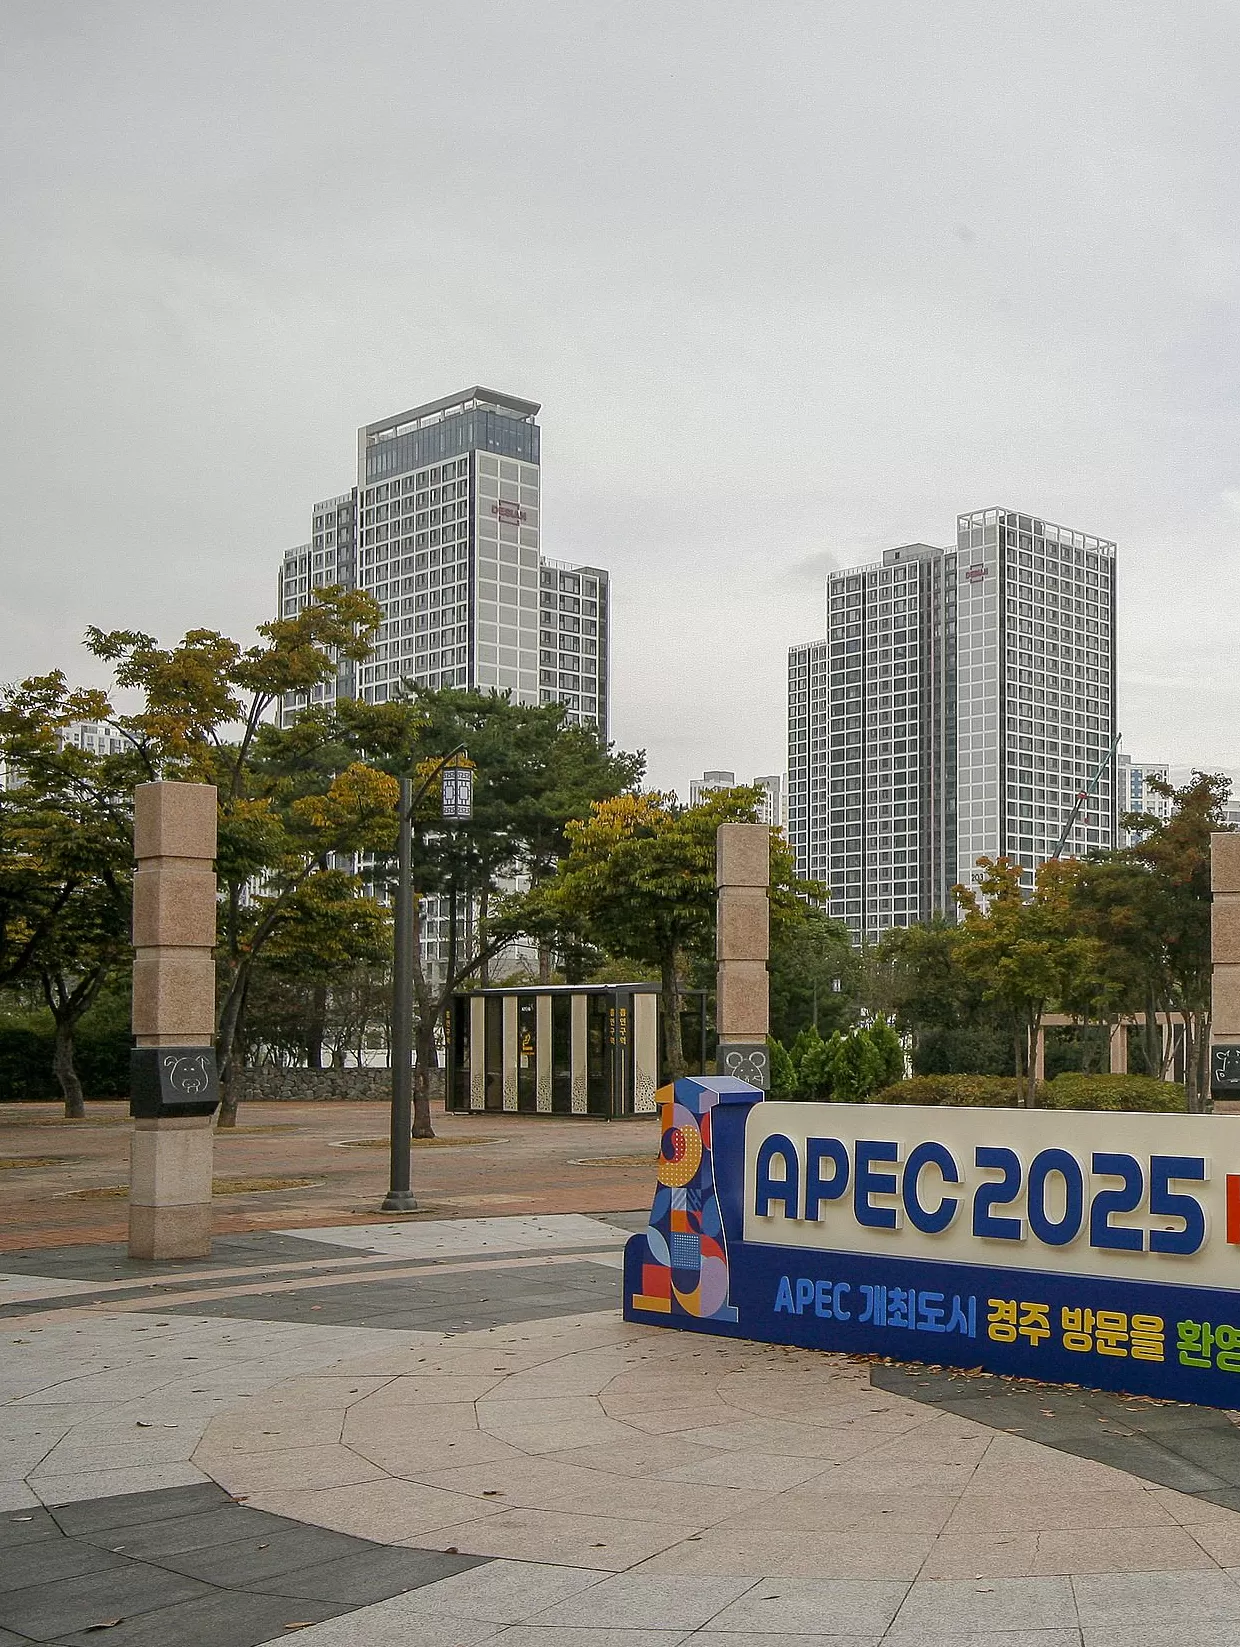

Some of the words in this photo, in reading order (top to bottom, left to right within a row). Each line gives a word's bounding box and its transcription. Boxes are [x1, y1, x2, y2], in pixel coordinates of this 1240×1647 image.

[971, 873, 984, 882] 203
[754, 1132, 965, 1234] APEC
[971, 1145, 1212, 1256] 2025
[774, 1275, 851, 1321] APEC
[858, 1284, 977, 1339] 개최도시
[987, 1298, 1051, 1348] 경주
[1060, 1306, 1166, 1363] 방문을
